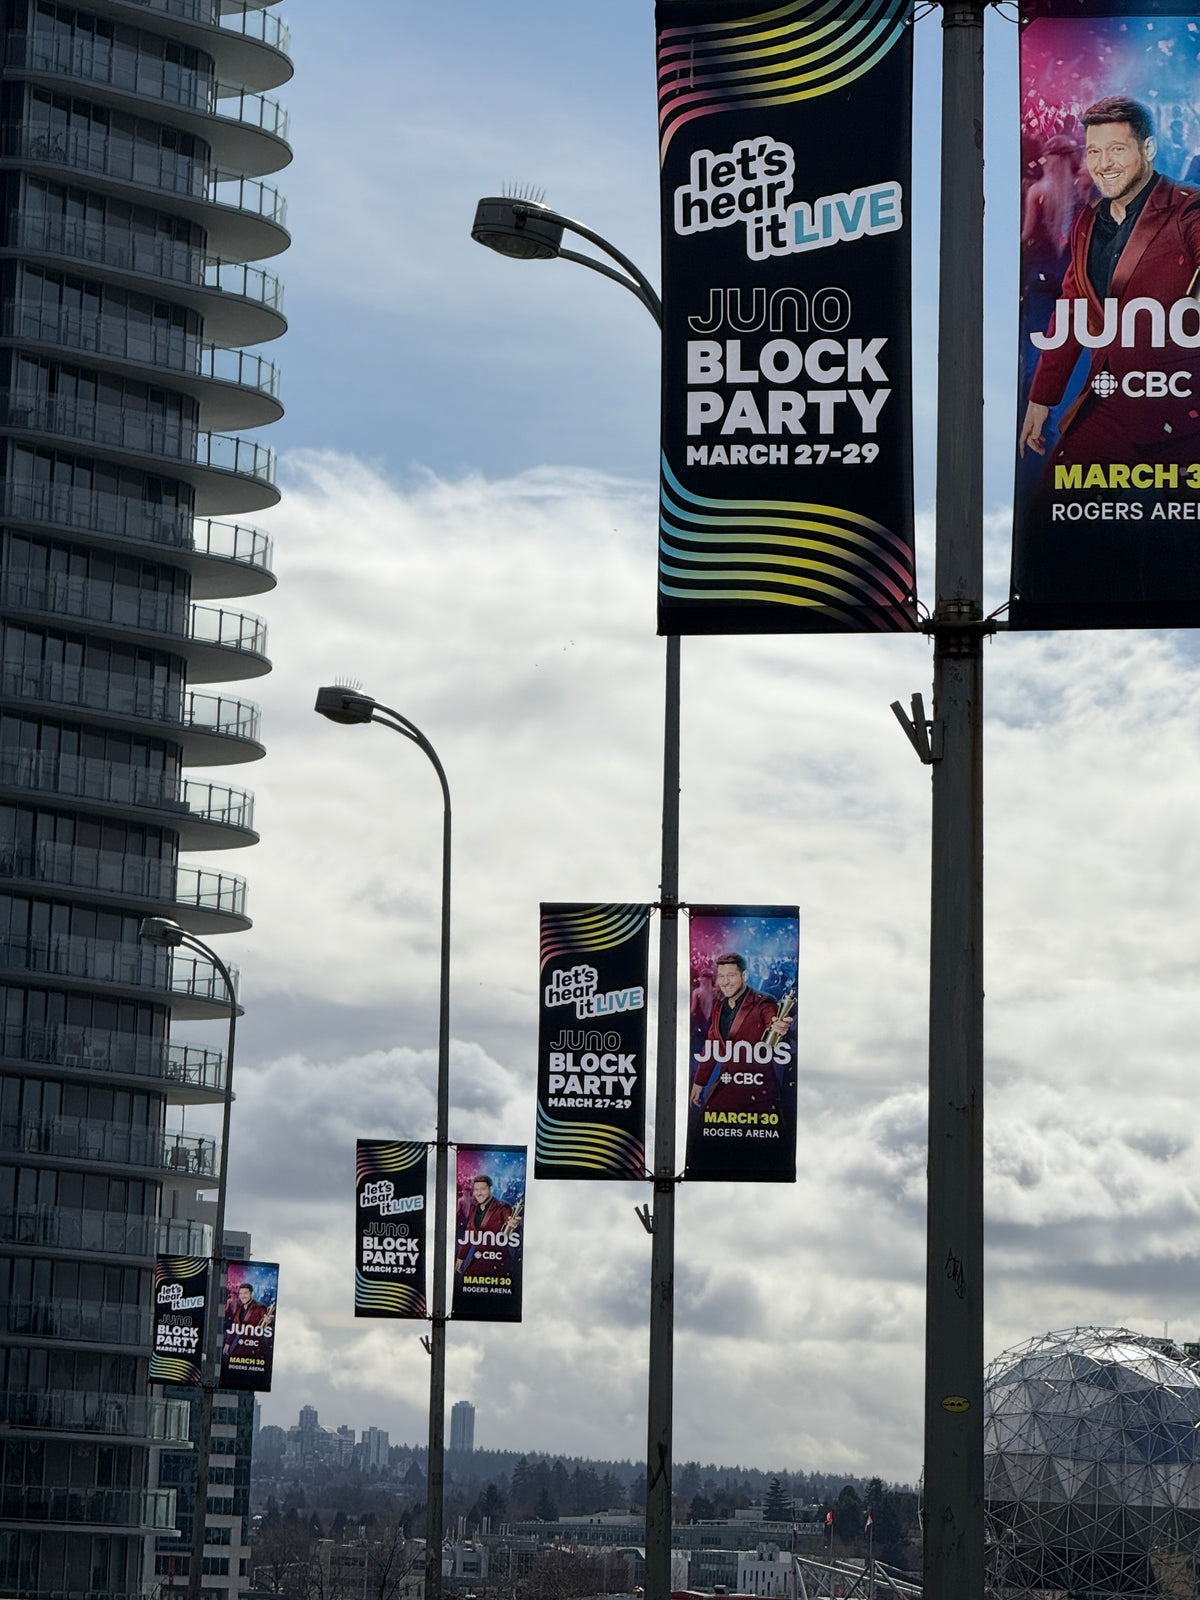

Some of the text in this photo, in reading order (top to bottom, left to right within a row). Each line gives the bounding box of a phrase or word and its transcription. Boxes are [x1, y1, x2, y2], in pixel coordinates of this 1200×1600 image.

[698, 143, 788, 192] let's
[682, 180, 786, 228] hear
[754, 188, 896, 253] it LIVE
[687, 286, 852, 334] JUNO
[686, 337, 890, 385] BLOCK
[1121, 370, 1193, 398] CBC
[686, 388, 893, 436] PARTY
[686, 442, 880, 466] MARCH 27-29
[1054, 463, 1179, 490] MARCH
[1051, 501, 1200, 522] ROGERS ARE
[555, 967, 596, 989] let's
[548, 983, 594, 1004] hear
[579, 989, 641, 1016] it LIVE
[549, 1029, 622, 1052] JUNO
[693, 1039, 792, 1065] JUNOS
[549, 1052, 637, 1074] BLOCK
[548, 1074, 638, 1096] PARTY
[733, 1072, 764, 1086] CBC
[547, 1097, 632, 1110] MARCH 27-29
[704, 1111, 779, 1126] MARCH 30
[702, 1127, 780, 1139] ROGERS ARENA
[366, 1182, 393, 1196] let's
[361, 1192, 392, 1206] hear
[381, 1196, 422, 1214] it LIVE
[363, 1221, 410, 1238] JUNO
[362, 1236, 420, 1252] BLOCK
[457, 1229, 521, 1248] JUNOS
[362, 1250, 420, 1266] PARTY
[482, 1251, 503, 1261] CBC
[362, 1265, 417, 1275] MARCH 27-29
[463, 1275, 512, 1286] MARCH 30
[158, 1292, 182, 1302] hear
[162, 1285, 183, 1296] let's
[462, 1286, 513, 1295] ROGERS ARENA
[181, 1296, 204, 1308] LIVE
[157, 1324, 200, 1338] BLOCK
[226, 1323, 273, 1338] JUNOS
[155, 1345, 178, 1353] MARCH
[156, 1334, 200, 1348] PARTY
[244, 1339, 260, 1347] CBC
[229, 1356, 266, 1366] MARCH 30
